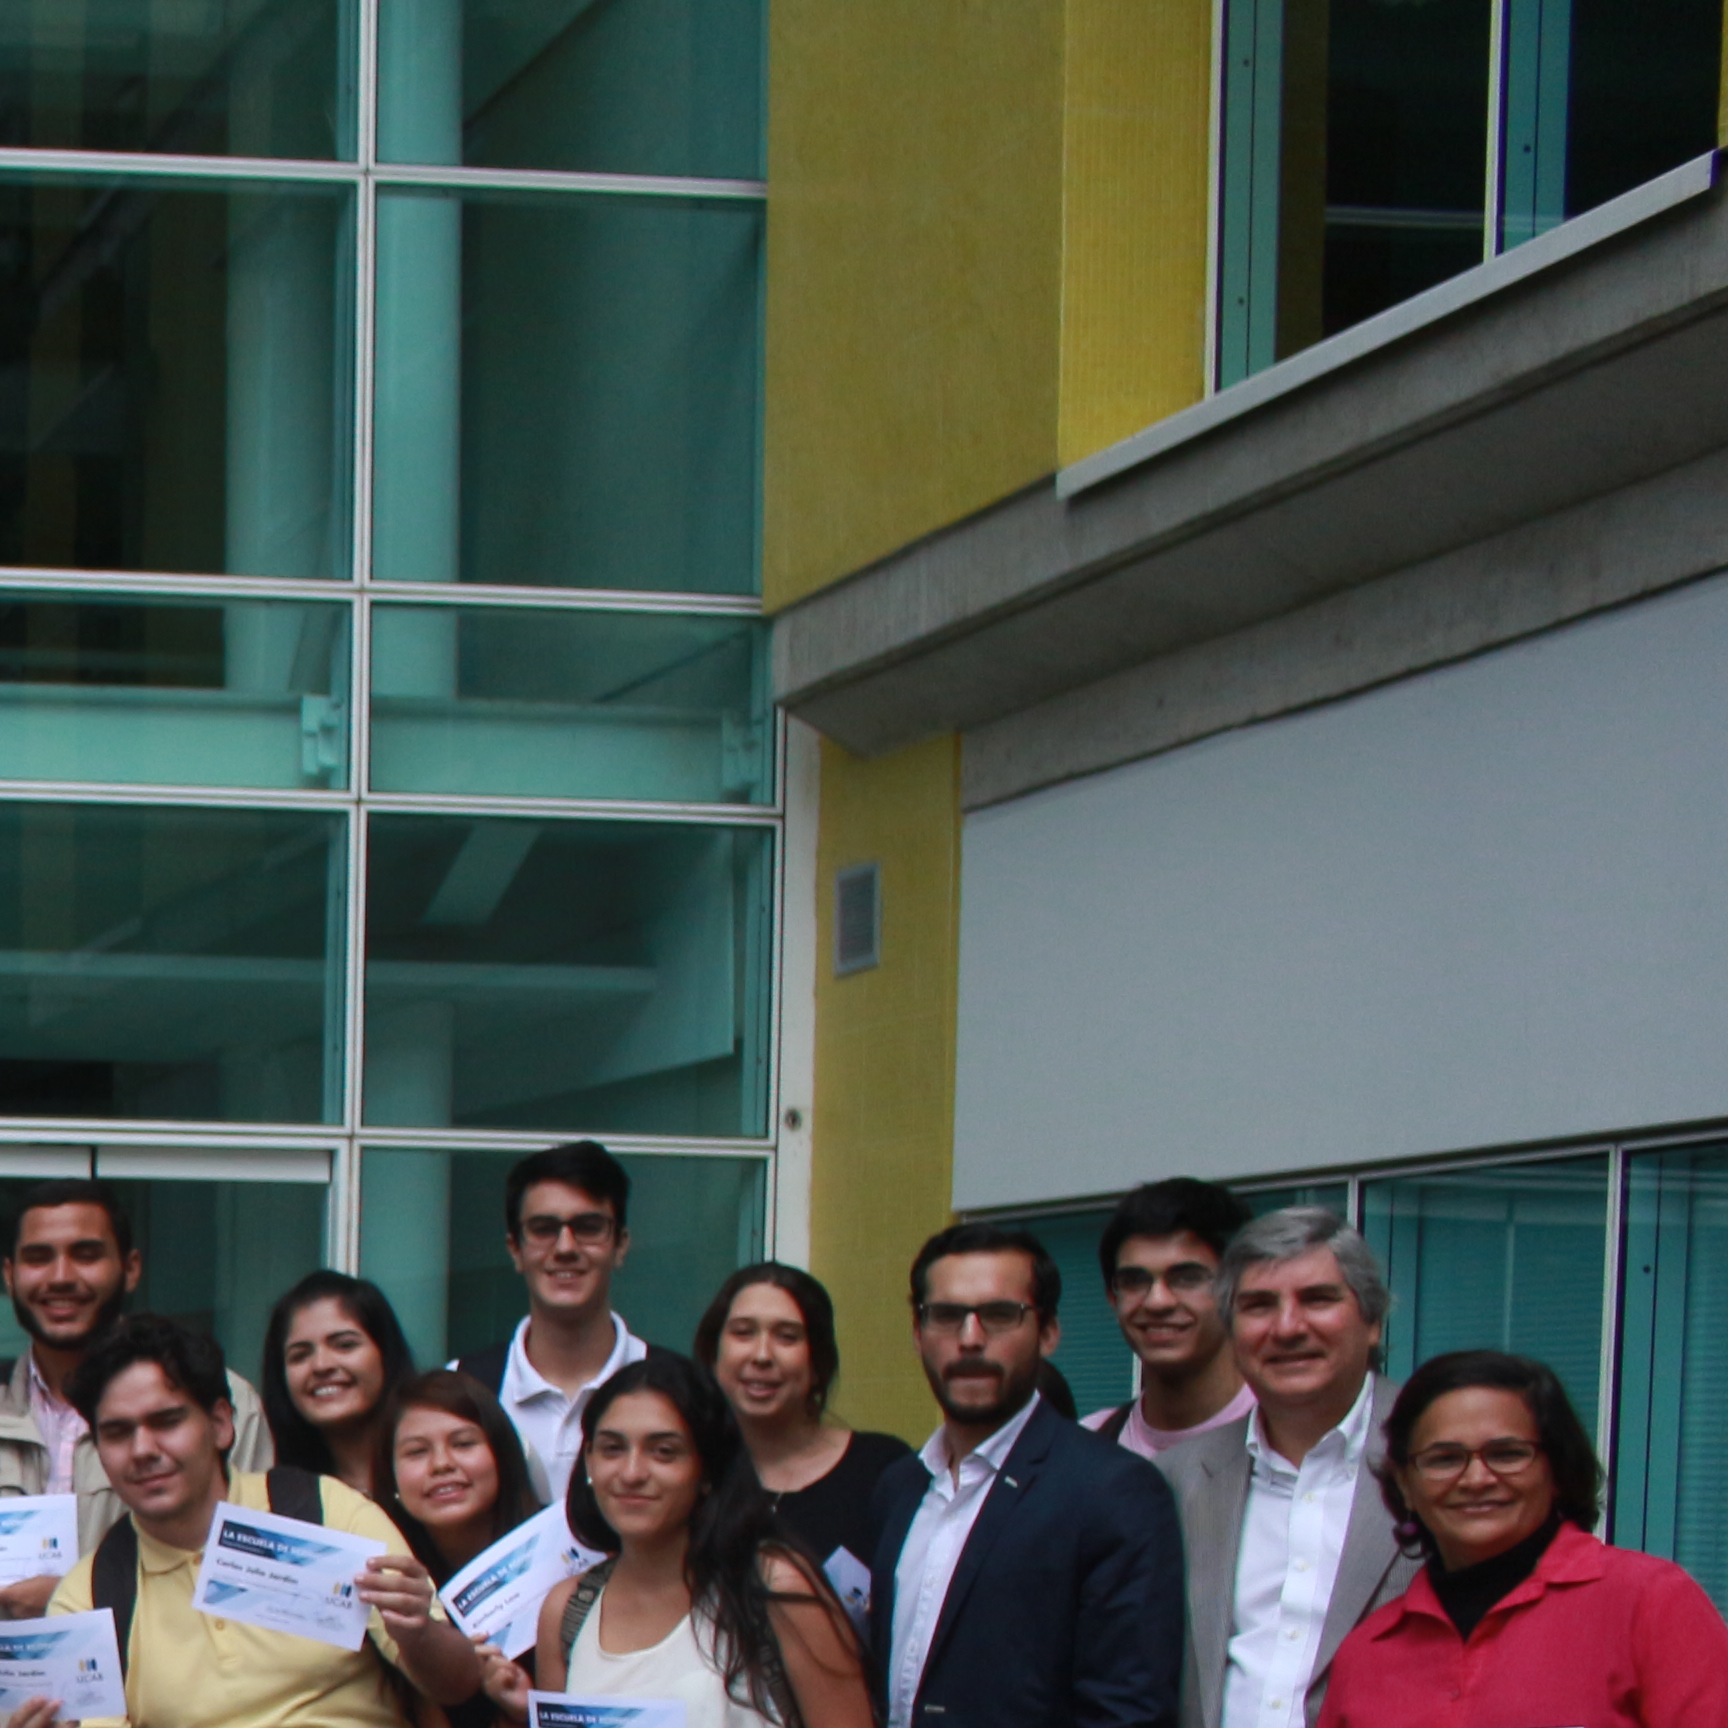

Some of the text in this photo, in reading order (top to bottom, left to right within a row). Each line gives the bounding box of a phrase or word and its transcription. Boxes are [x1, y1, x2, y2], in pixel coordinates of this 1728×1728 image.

[223, 1529, 235, 1539] LA
[237, 1533, 275, 1549] ESCUELA
[540, 1712, 549, 1720] LA
[551, 1713, 584, 1722] ESCUELA
